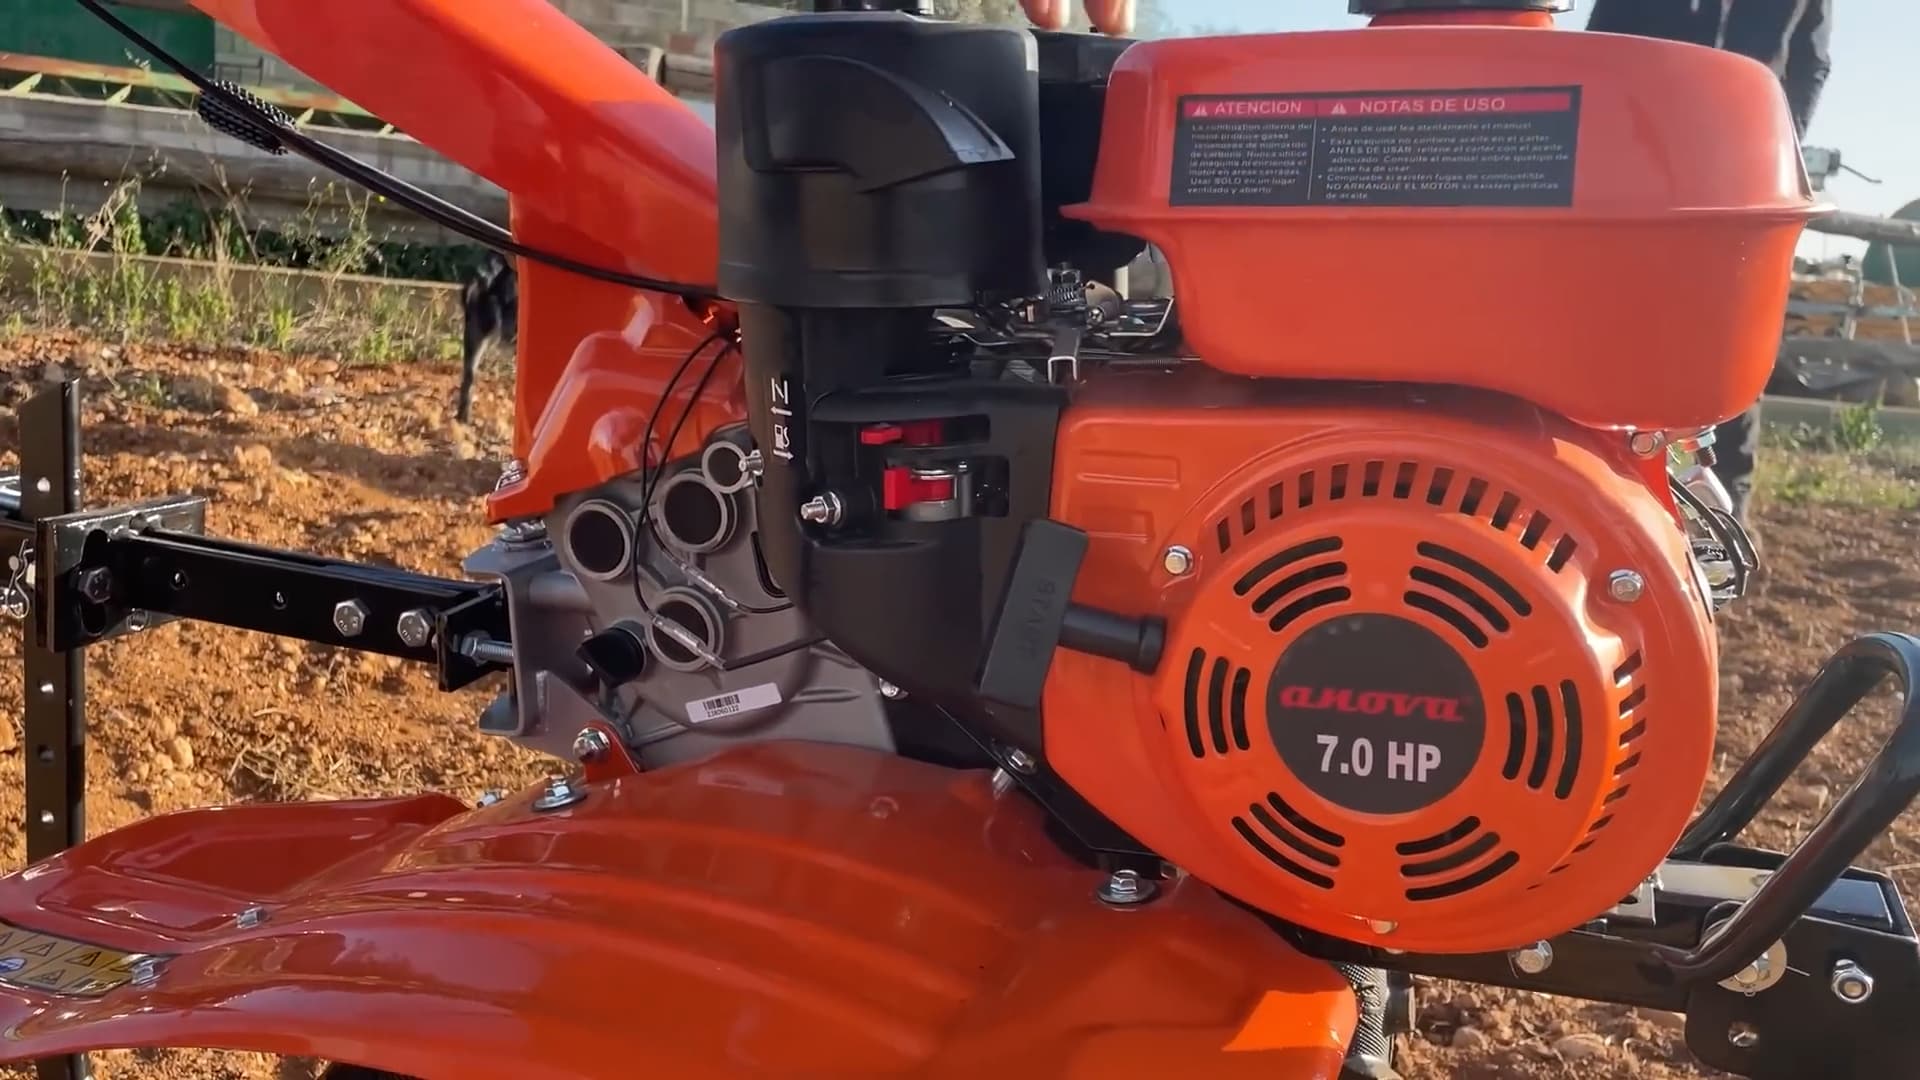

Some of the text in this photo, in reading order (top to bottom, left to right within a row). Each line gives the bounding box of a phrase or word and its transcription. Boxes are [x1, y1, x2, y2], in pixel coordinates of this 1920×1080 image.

[1214, 100, 1302, 114] ATENCION
[1359, 97, 1506, 113] NOTAS DE USO
[1329, 146, 1363, 154] ANTES
[1366, 146, 1379, 154] DE
[1190, 177, 1212, 185] Usar
[1272, 177, 1296, 187] lugar
[1342, 183, 1401, 191] ARRANQUE
[1420, 182, 1458, 190] MOTOR
[1231, 188, 1238, 196] y
[1279, 684, 1464, 723] anova
[1316, 734, 1442, 783] 7.0 HP
